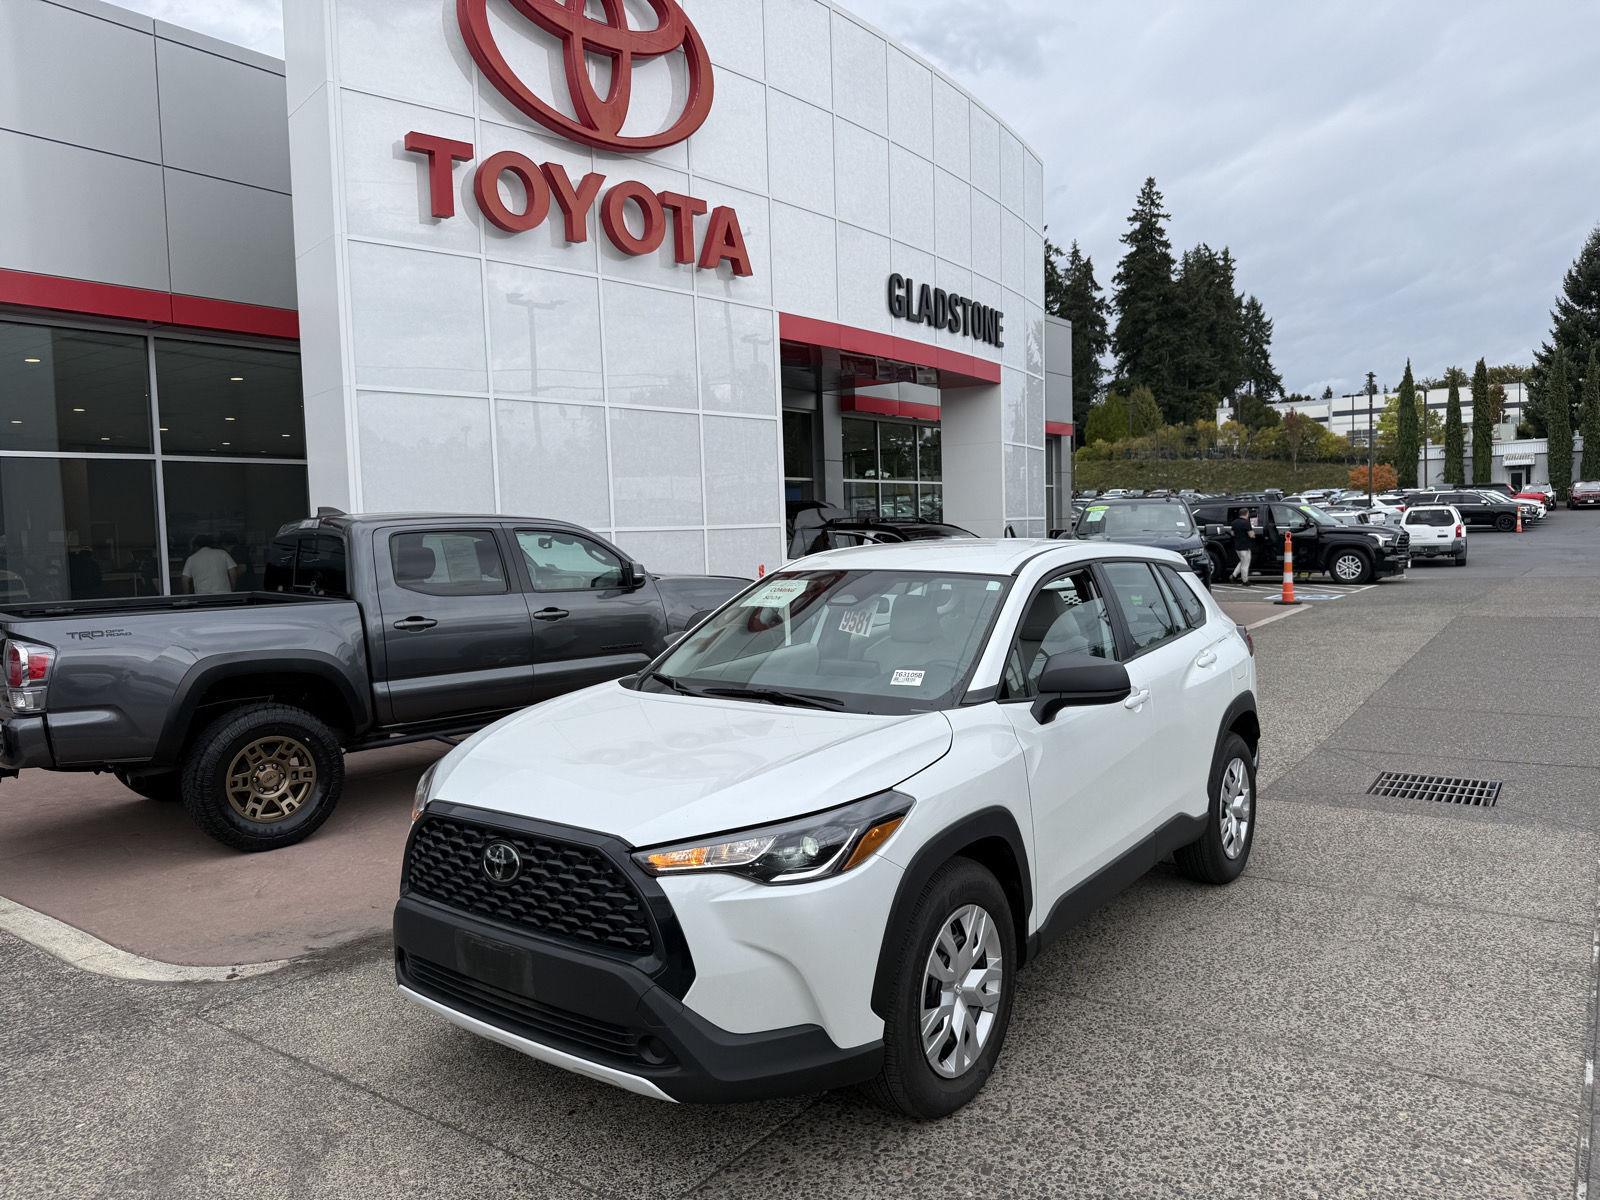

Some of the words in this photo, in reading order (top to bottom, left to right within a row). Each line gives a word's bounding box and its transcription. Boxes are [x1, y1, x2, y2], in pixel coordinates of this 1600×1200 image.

[404, 130, 754, 277] TOYOTA
[887, 272, 1005, 349] GLADSTONE
[66, 630, 104, 640] TRD
[841, 609, 872, 635] 9581
